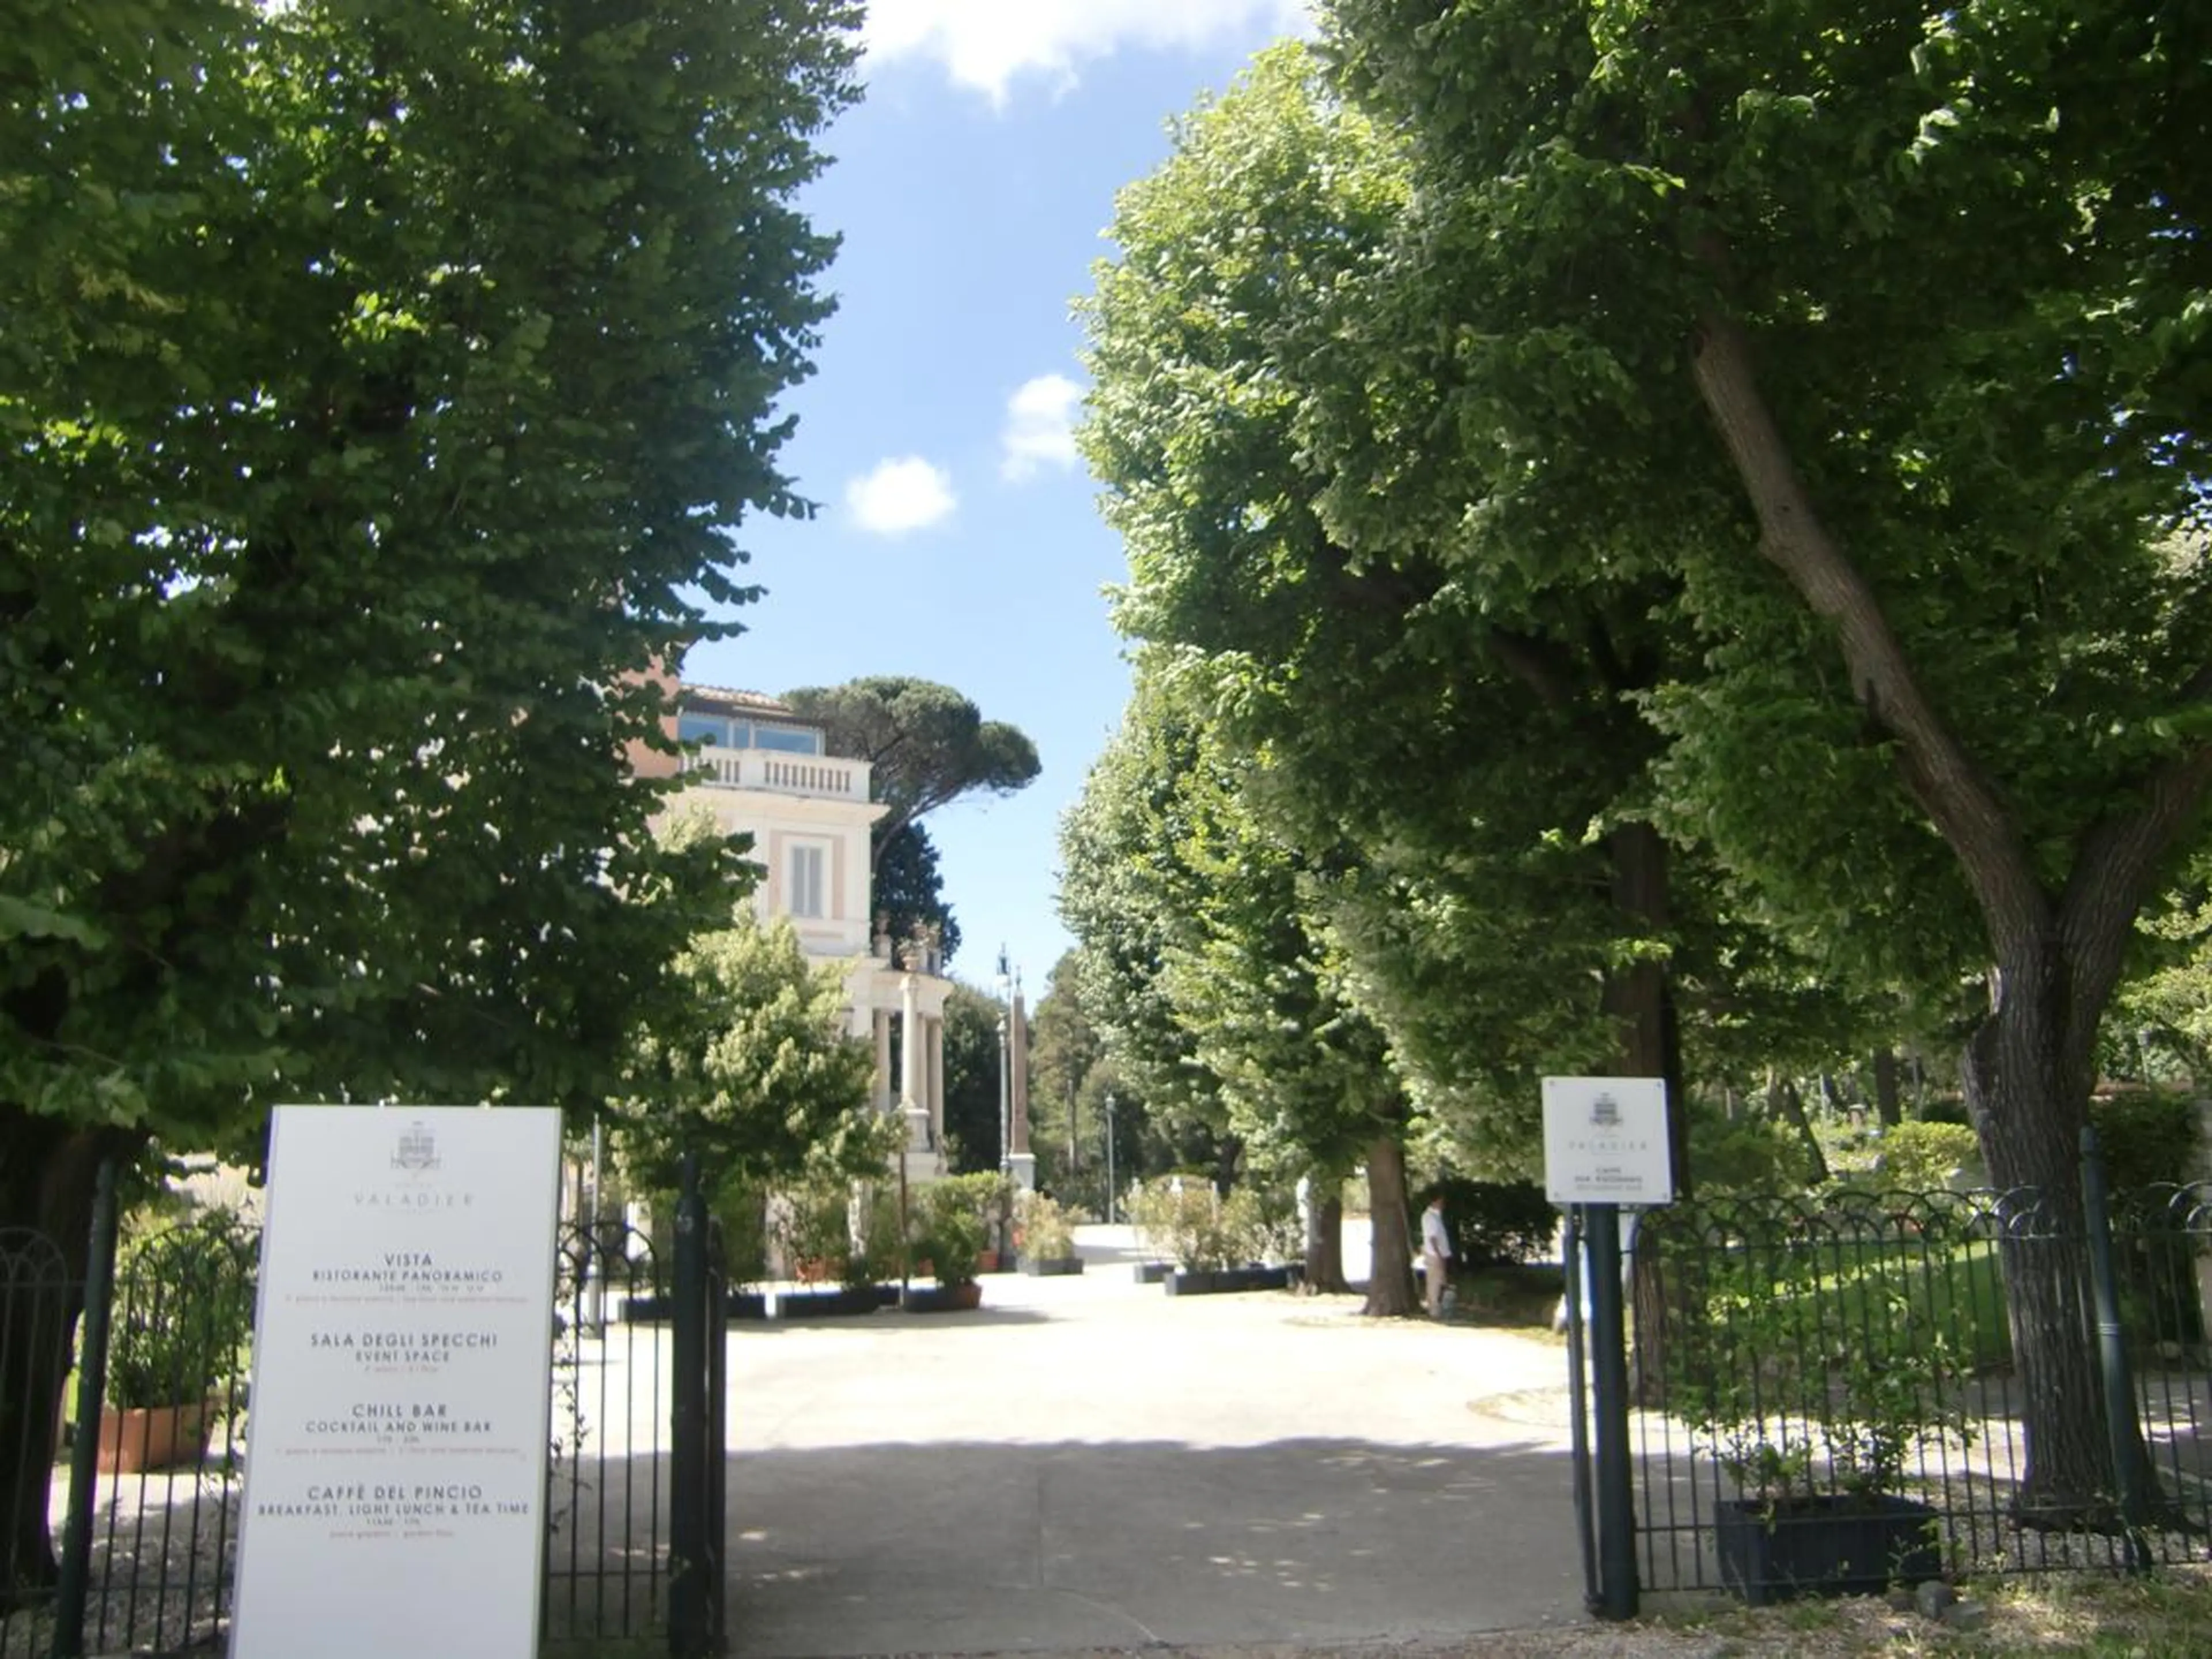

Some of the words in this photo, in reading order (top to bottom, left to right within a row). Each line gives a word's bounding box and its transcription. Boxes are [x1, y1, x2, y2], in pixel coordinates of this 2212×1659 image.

[385, 1253, 433, 1266] VISTA
[313, 1270, 395, 1282] RISTORANTE
[402, 1271, 502, 1282] PANORAMICO
[312, 1334, 354, 1347] SALA
[362, 1334, 414, 1347] DEGLI
[422, 1334, 497, 1347] SPECCHI
[355, 1351, 398, 1362] EVENT
[406, 1351, 449, 1362] SPACE
[353, 1404, 403, 1417] CHILL
[412, 1404, 446, 1417] BAR
[306, 1422, 377, 1433] COCKTAIL
[386, 1422, 416, 1433] AND
[423, 1422, 457, 1433] WINE
[464, 1422, 491, 1433] BAR
[375, 1487, 406, 1500] DEL
[415, 1486, 482, 1500] PINCIO
[350, 1504, 389, 1515] LIGHT
[396, 1504, 444, 1515] LUNCH
[466, 1504, 490, 1515] TEA
[497, 1504, 529, 1515] TIME
